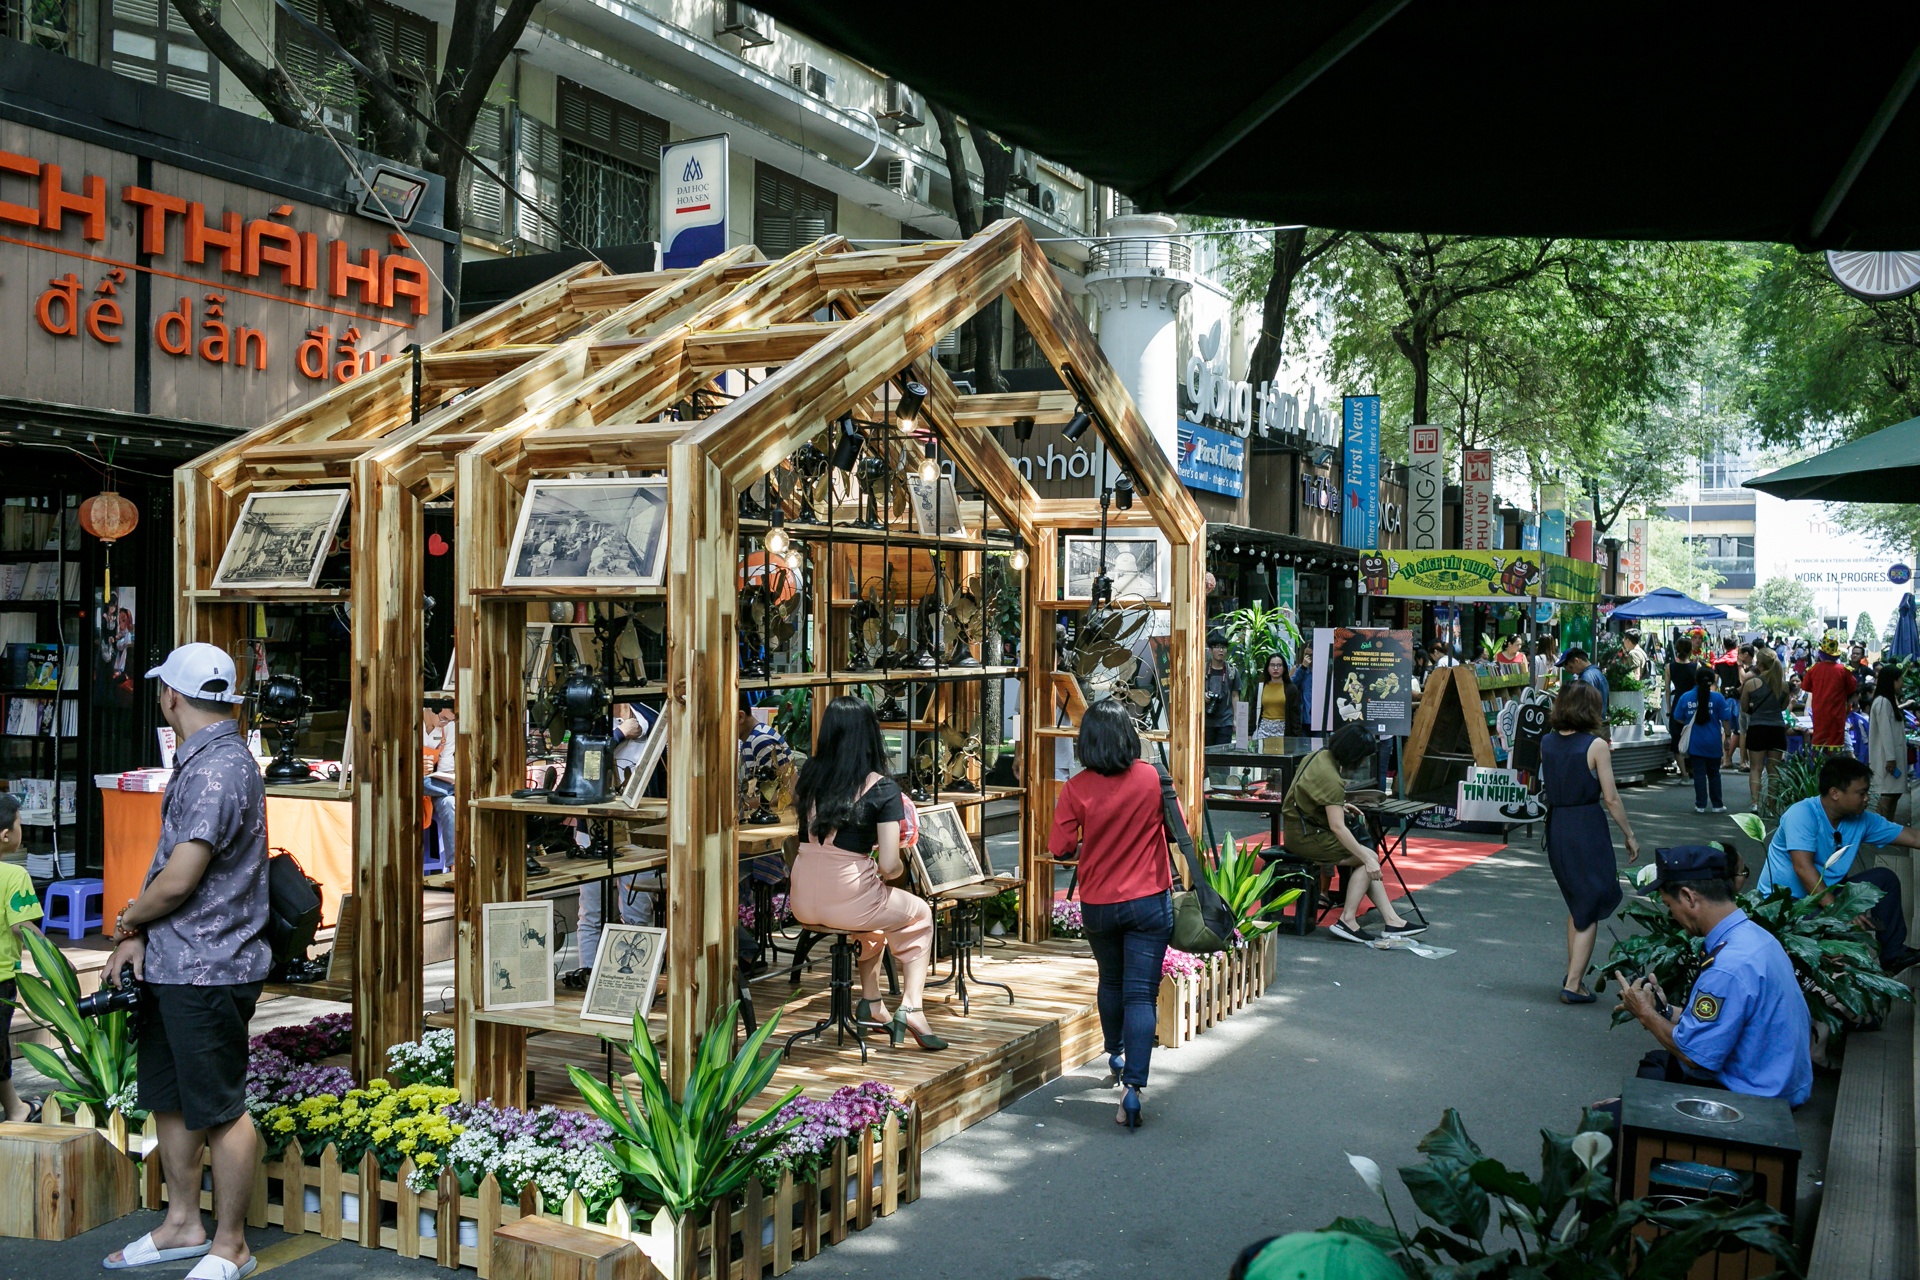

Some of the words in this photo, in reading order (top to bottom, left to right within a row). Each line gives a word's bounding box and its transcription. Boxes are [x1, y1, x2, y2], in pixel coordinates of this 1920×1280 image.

[676, 196, 693, 205] HOA
[694, 193, 710, 203] SEN
[122, 185, 318, 290] THÁI
[329, 233, 429, 317] HÀ
[35, 267, 124, 344] để
[154, 293, 267, 371] dẫn
[1371, 399, 1379, 417] way
[1348, 401, 1364, 444] News
[1368, 425, 1377, 455] there's
[1347, 448, 1363, 486] First
[1368, 464, 1376, 479] will
[1368, 489, 1376, 518] there's
[1367, 520, 1375, 546] Where
[1463, 537, 1473, 550] HÀ
[1795, 572, 1823, 582] WORK
[1827, 572, 1838, 582] IN
[1409, 616, 1422, 624] 50
[1488, 771, 1510, 786] SÁCH
[1463, 780, 1485, 801] TÍN
